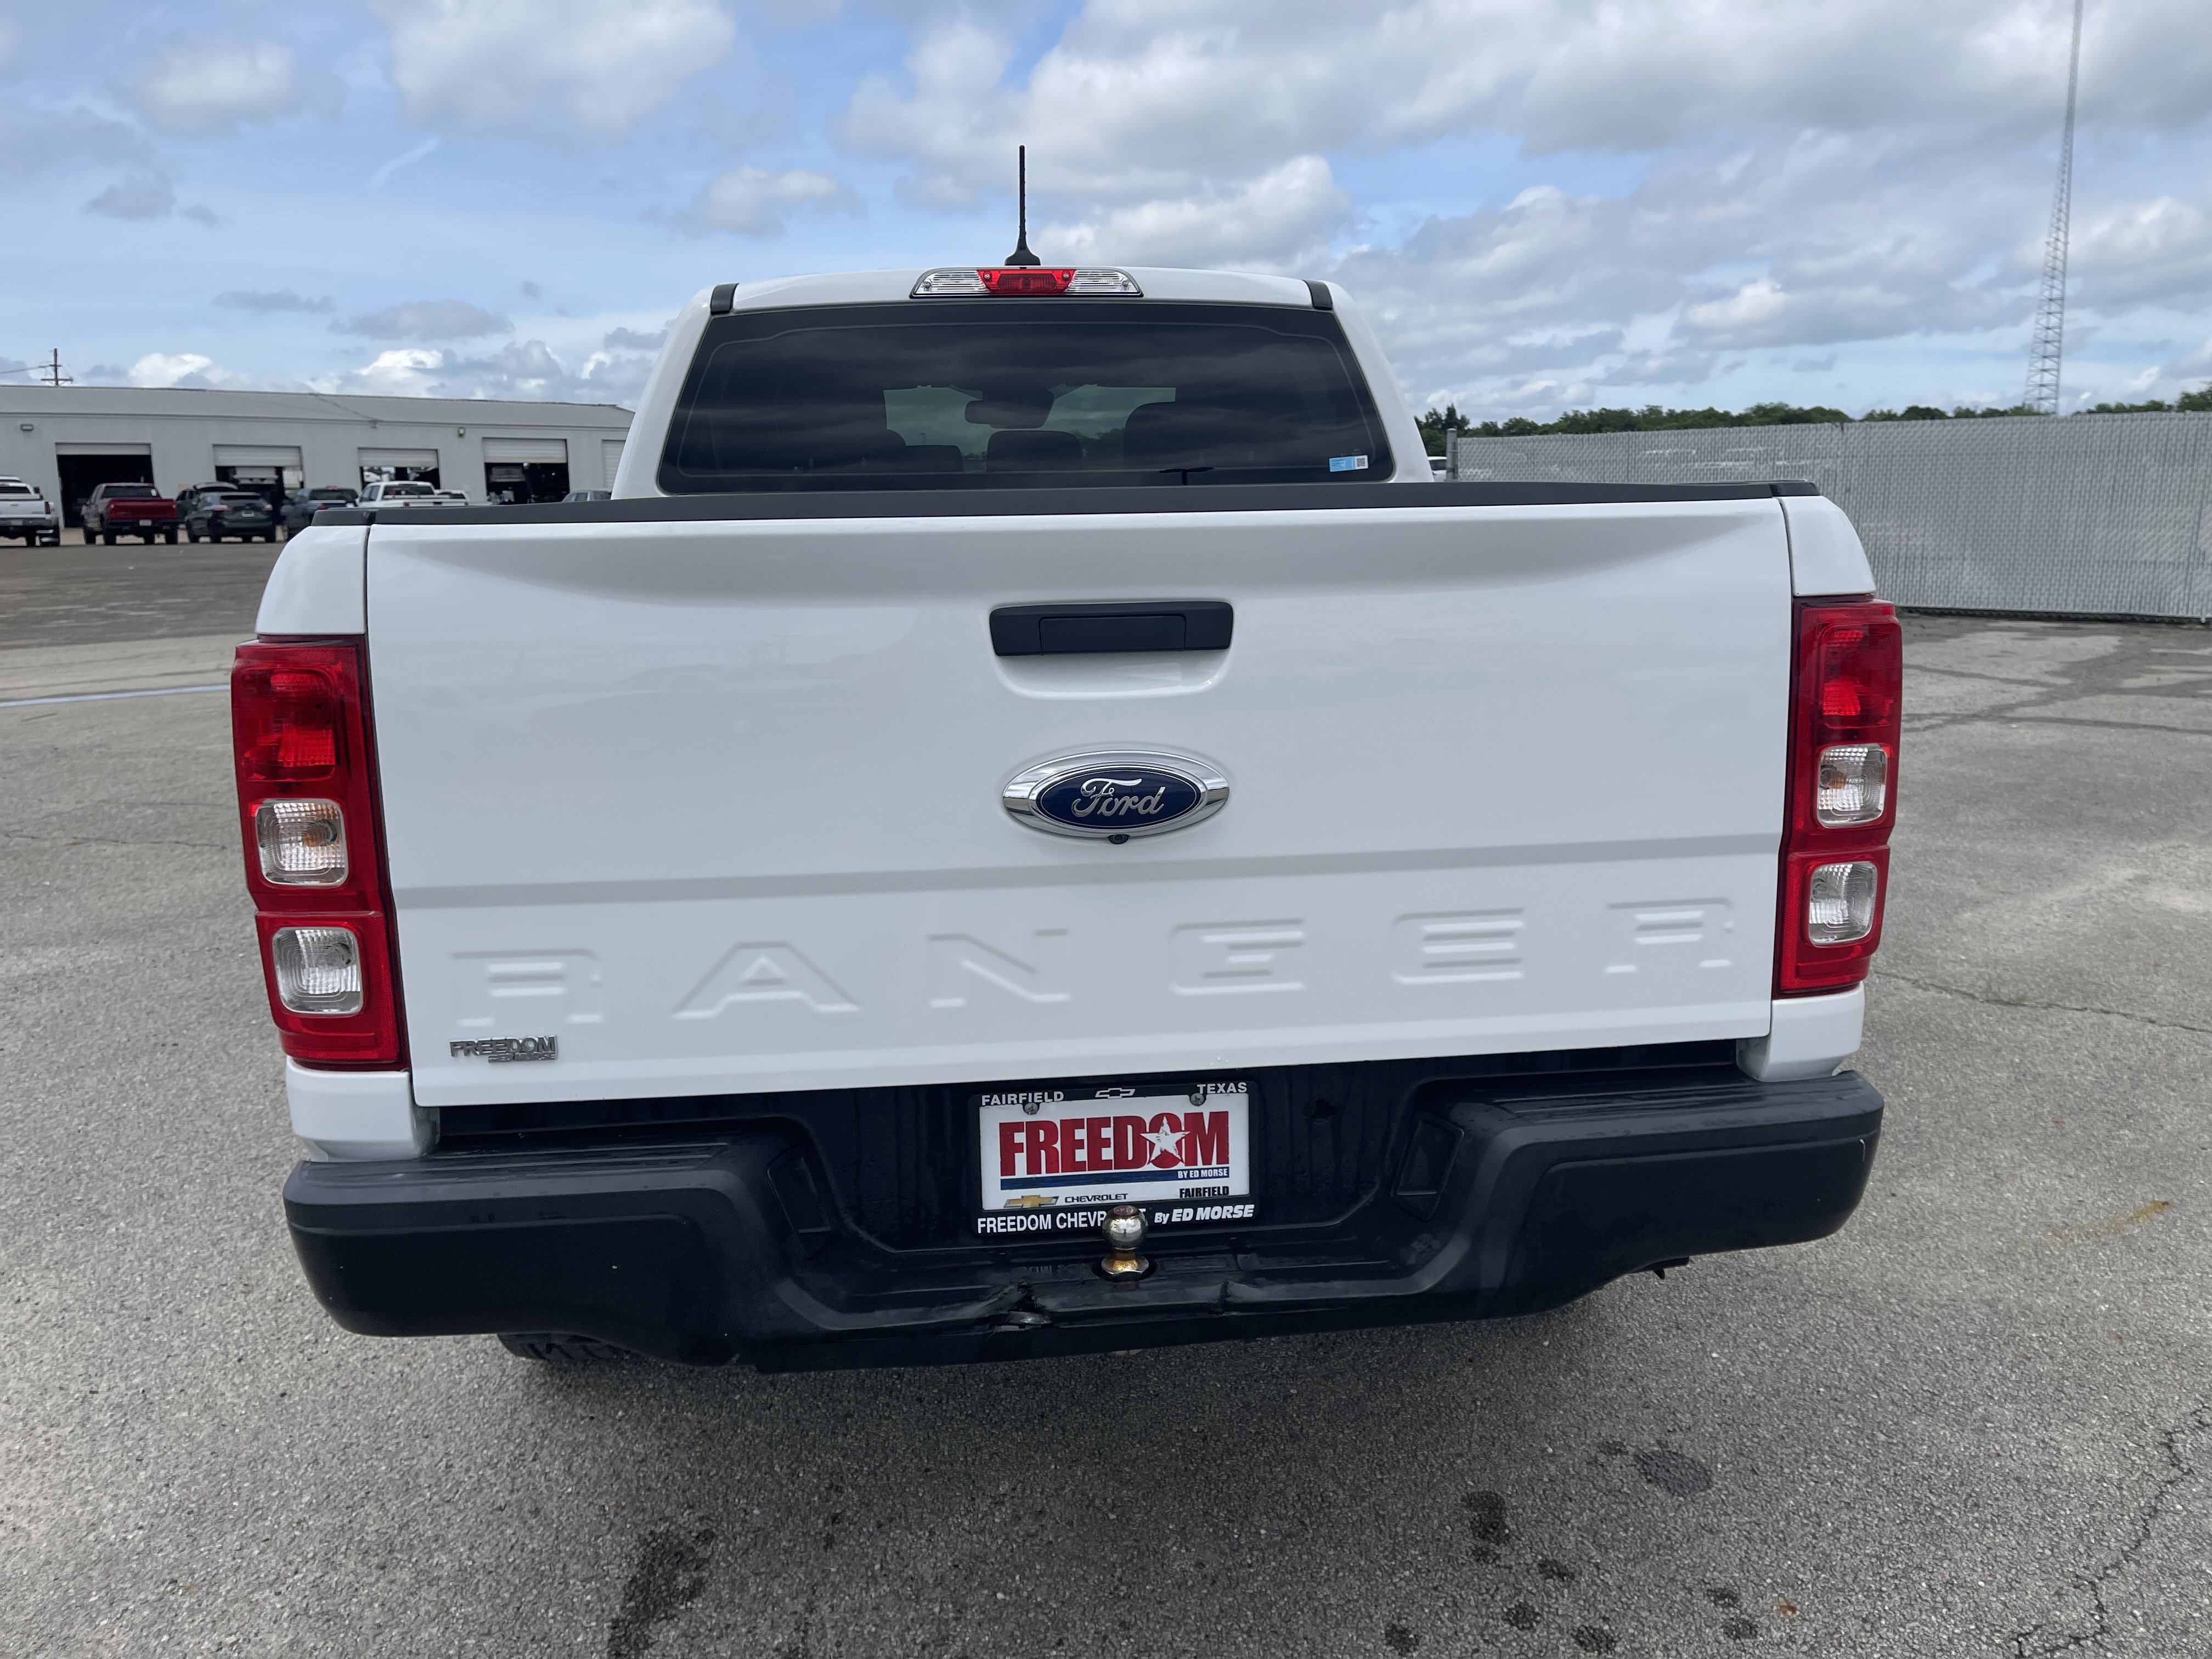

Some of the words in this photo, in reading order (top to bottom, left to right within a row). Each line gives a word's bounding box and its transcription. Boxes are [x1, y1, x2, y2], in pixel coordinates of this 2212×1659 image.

[1071, 778, 1166, 817] Ford
[451, 895, 1736, 1027] RANGER
[449, 1035, 557, 1057] FREEDOM
[1197, 1082, 1248, 1094] TEXAS
[981, 1091, 1064, 1106] FAIRFIELD
[999, 1110, 1229, 1177] FREEDOM
[1177, 1170, 1188, 1179] BY
[1189, 1170, 1199, 1178] ED
[1200, 1168, 1228, 1177] MORSE
[1064, 1193, 1128, 1203] CHEVROLET
[1180, 1186, 1229, 1198] FAIRFIELD
[978, 1214, 1052, 1234] FREEDOM
[1056, 1208, 1147, 1228] CHEVR
[1154, 1212, 1170, 1224] By
[1171, 1207, 1194, 1222] ED
[1195, 1204, 1255, 1221] MORSE
